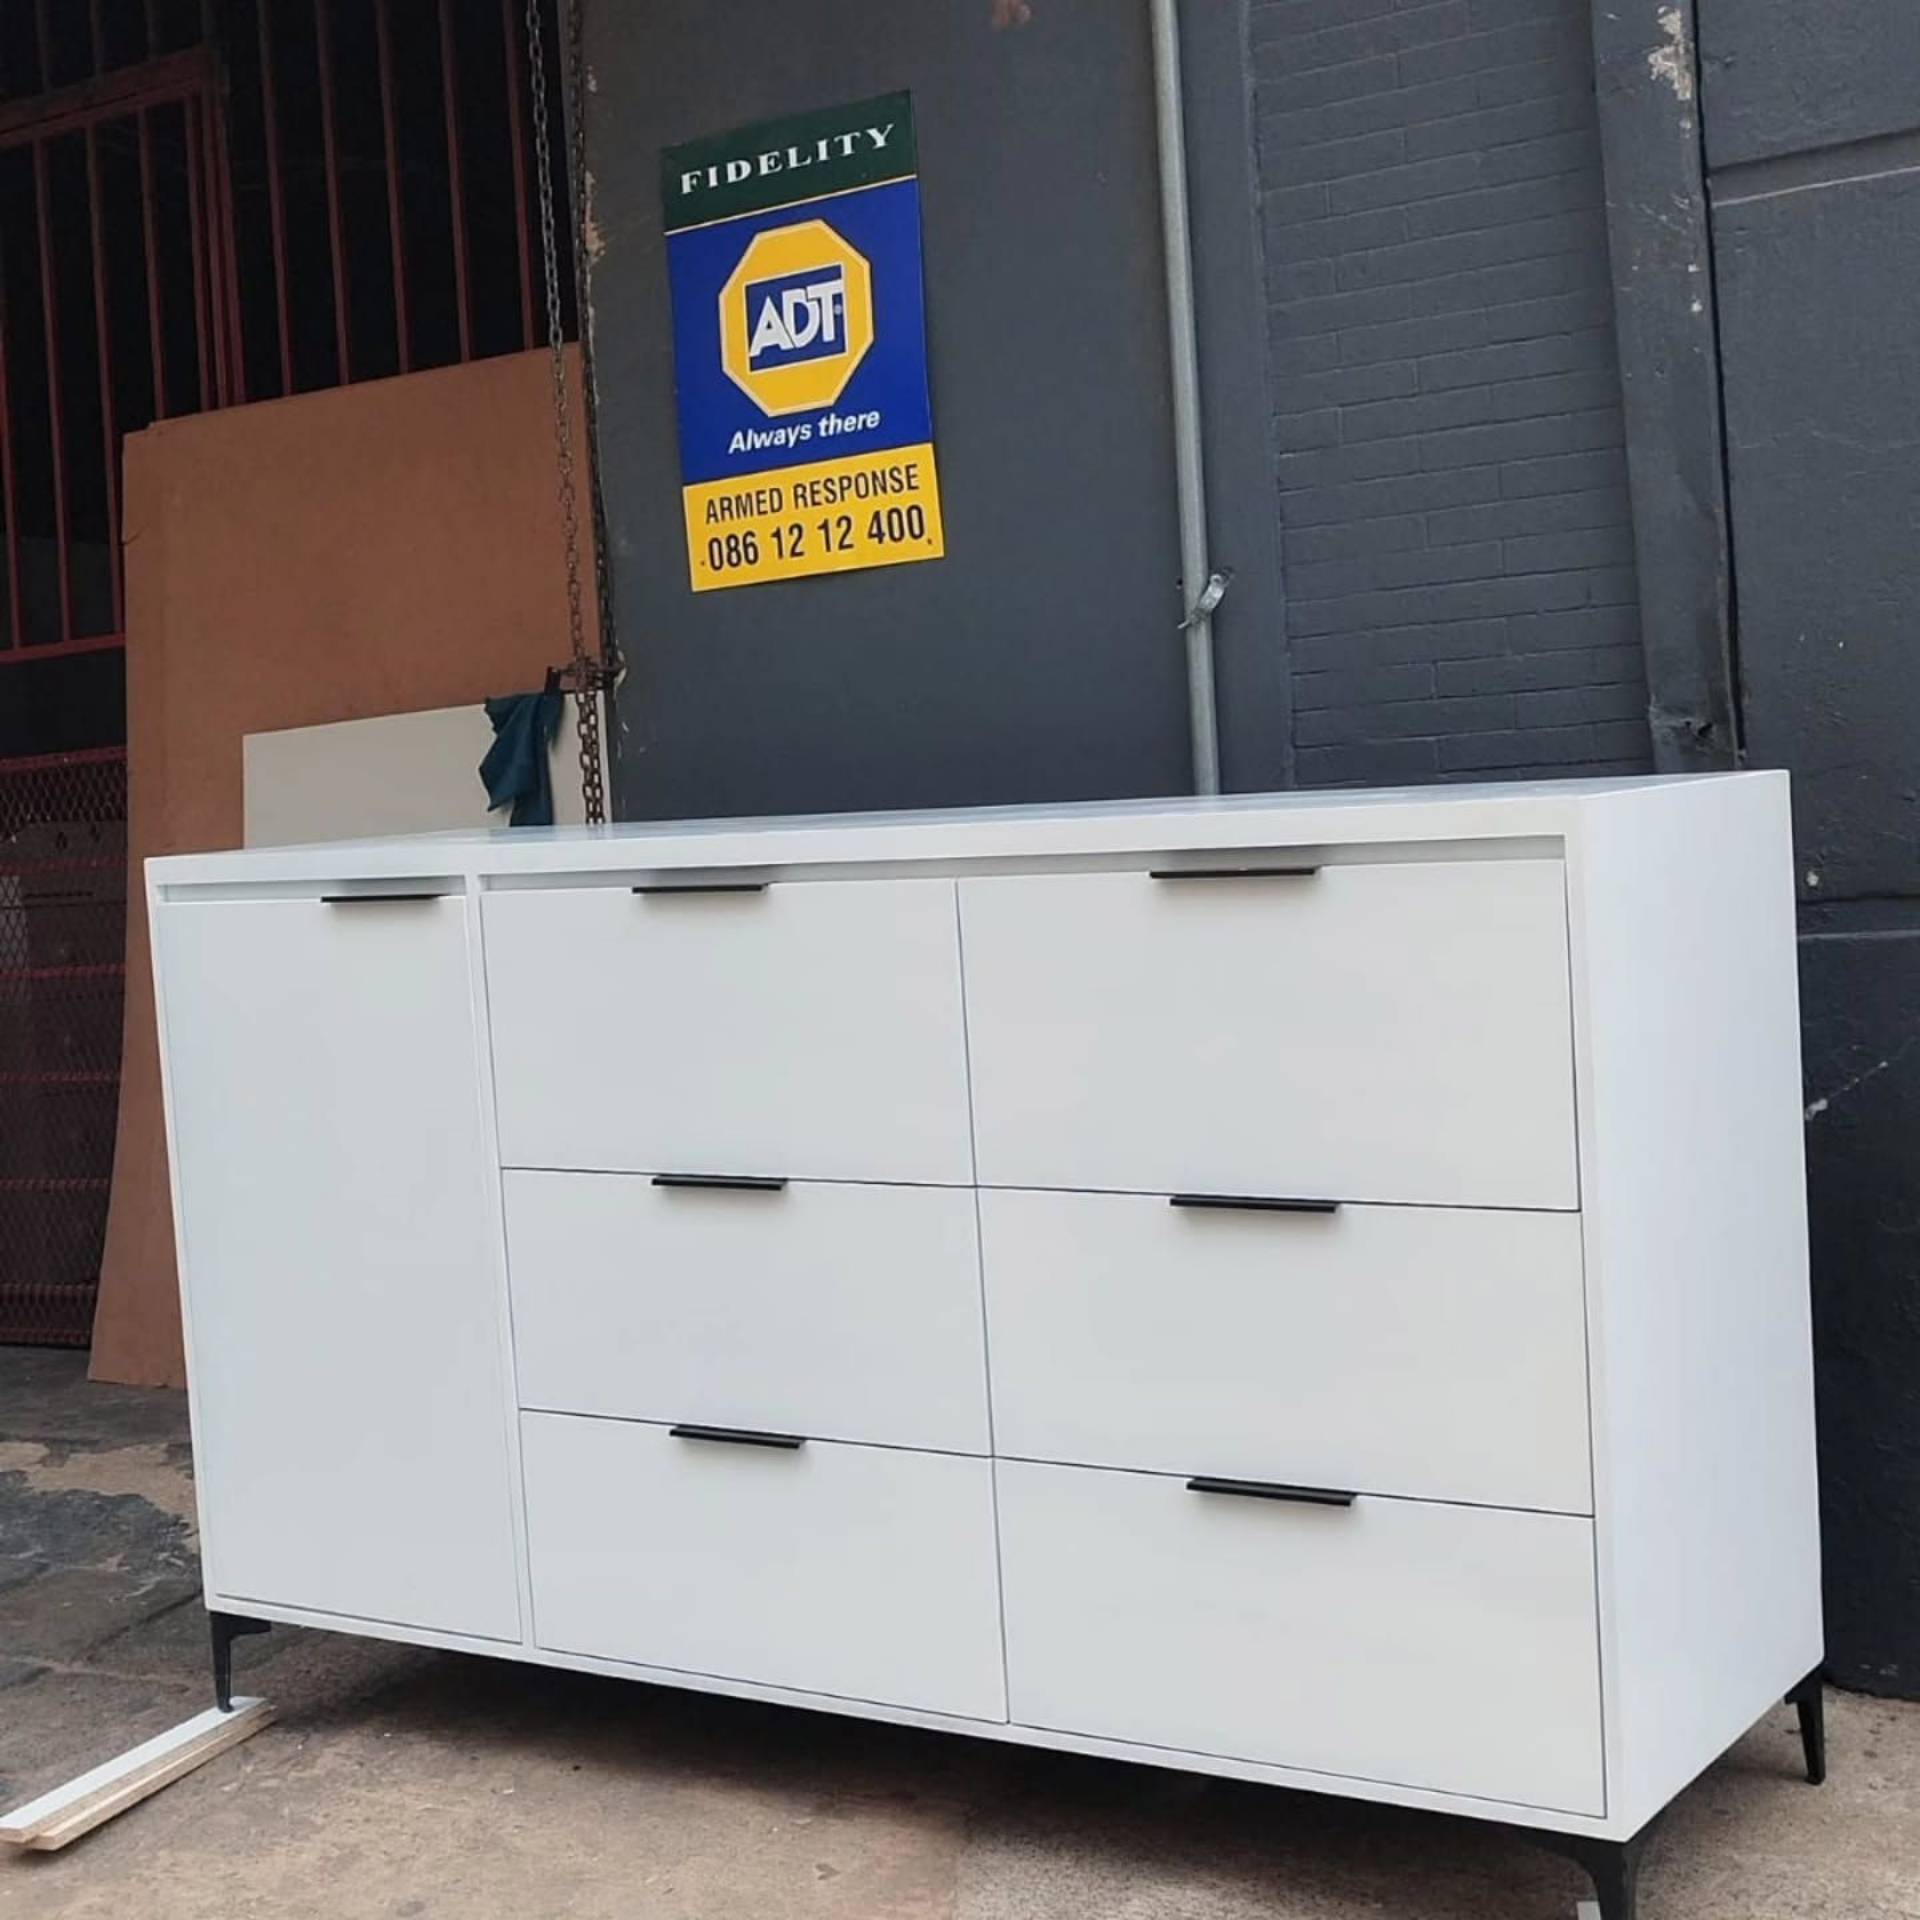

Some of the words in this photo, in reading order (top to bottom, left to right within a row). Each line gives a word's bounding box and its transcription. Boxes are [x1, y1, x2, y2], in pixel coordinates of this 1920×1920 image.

[680, 123, 895, 194] FIDELITY
[750, 279, 844, 357] ADT
[728, 422, 812, 454] Always
[818, 410, 880, 437] there
[706, 487, 783, 524] ARMED
[793, 463, 919, 509] RESPONSE
[707, 530, 759, 571] 086
[771, 523, 805, 559] 12
[817, 515, 854, 552] 12
[868, 504, 924, 544] 400
